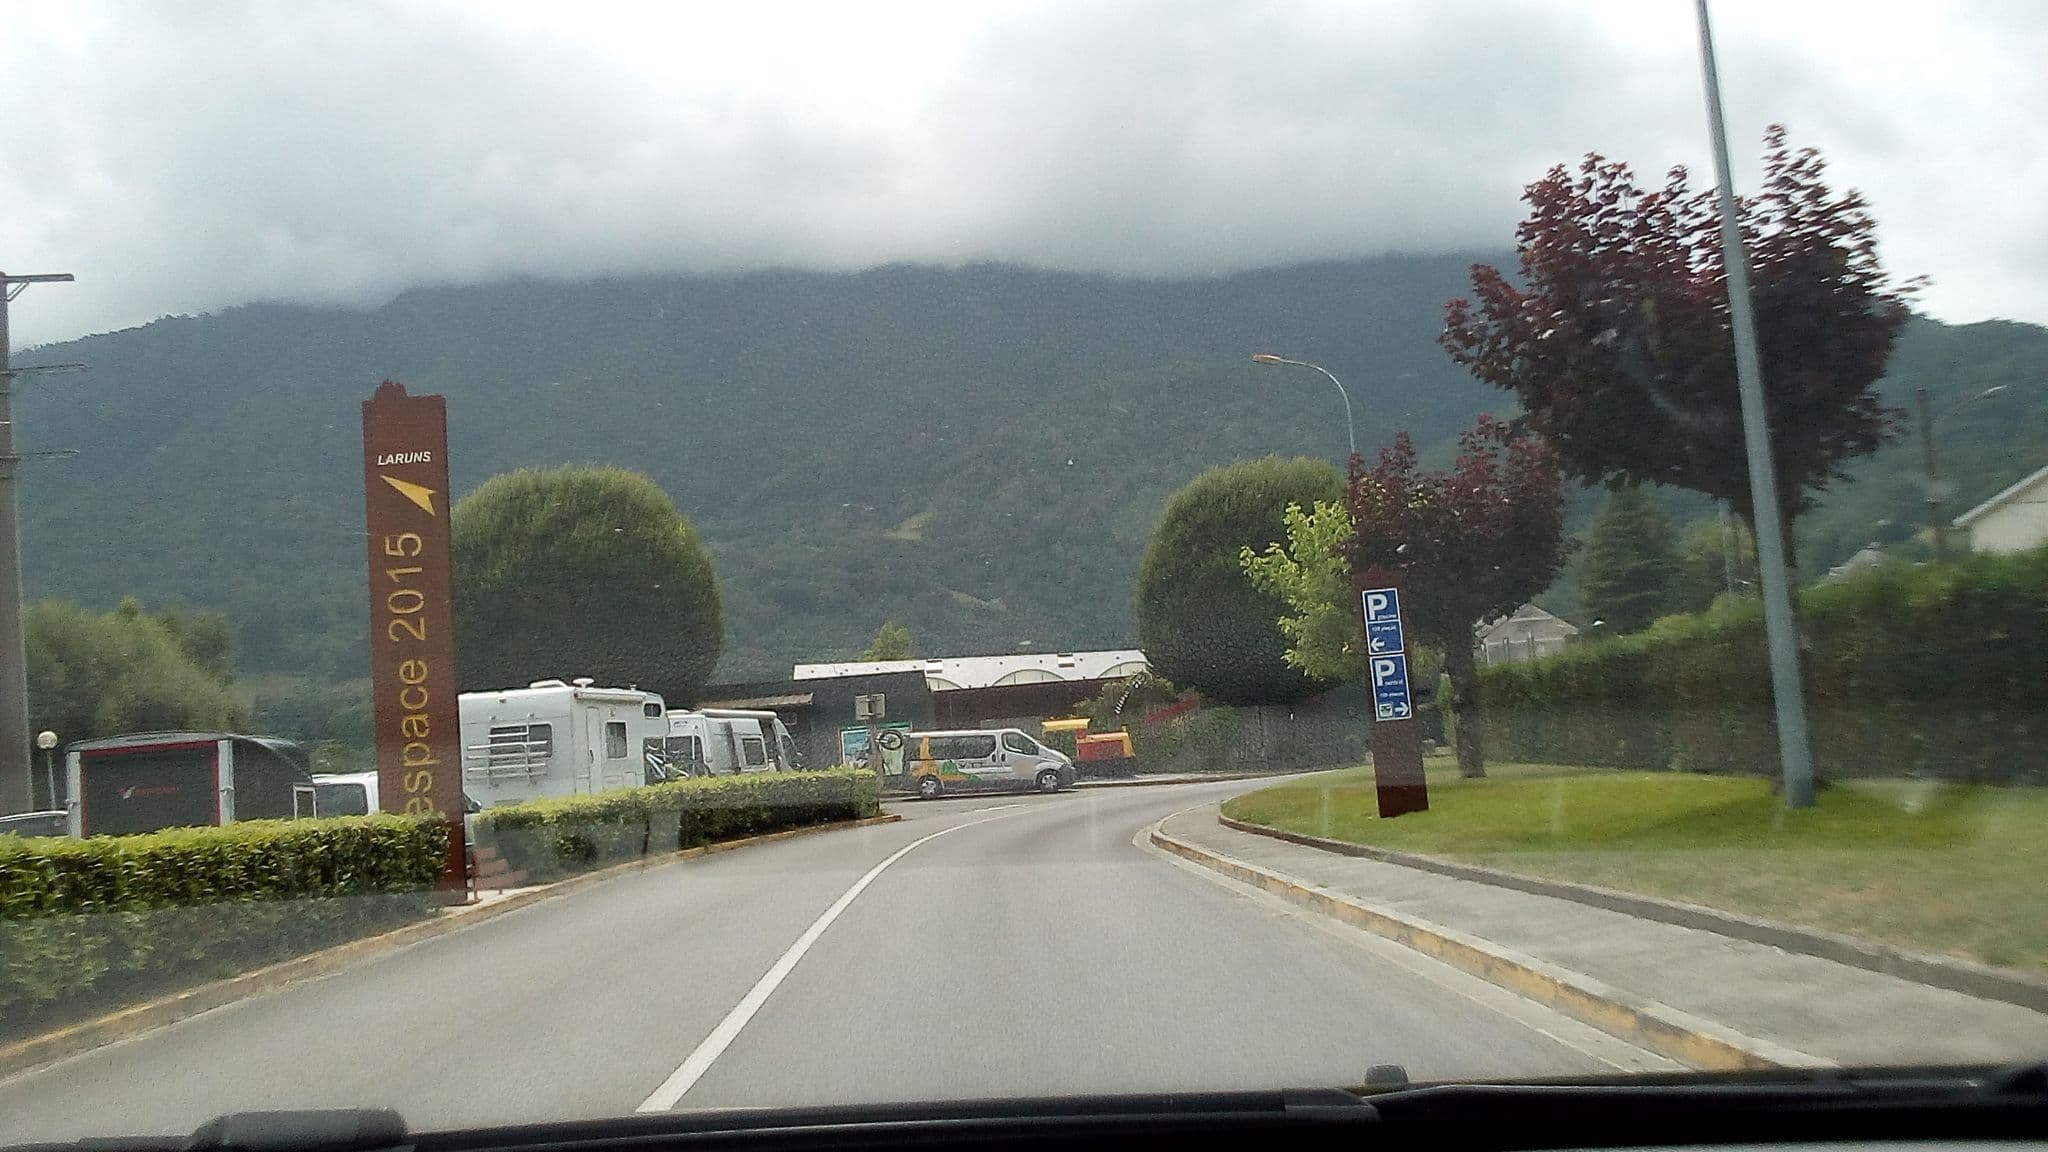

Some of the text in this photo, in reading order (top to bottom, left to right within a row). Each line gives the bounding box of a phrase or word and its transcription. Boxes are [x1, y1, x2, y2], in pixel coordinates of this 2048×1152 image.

[377, 451, 432, 466] LARUNS
[385, 532, 425, 642] 2015
[1367, 593, 1388, 621] P
[1374, 659, 1395, 687] P
